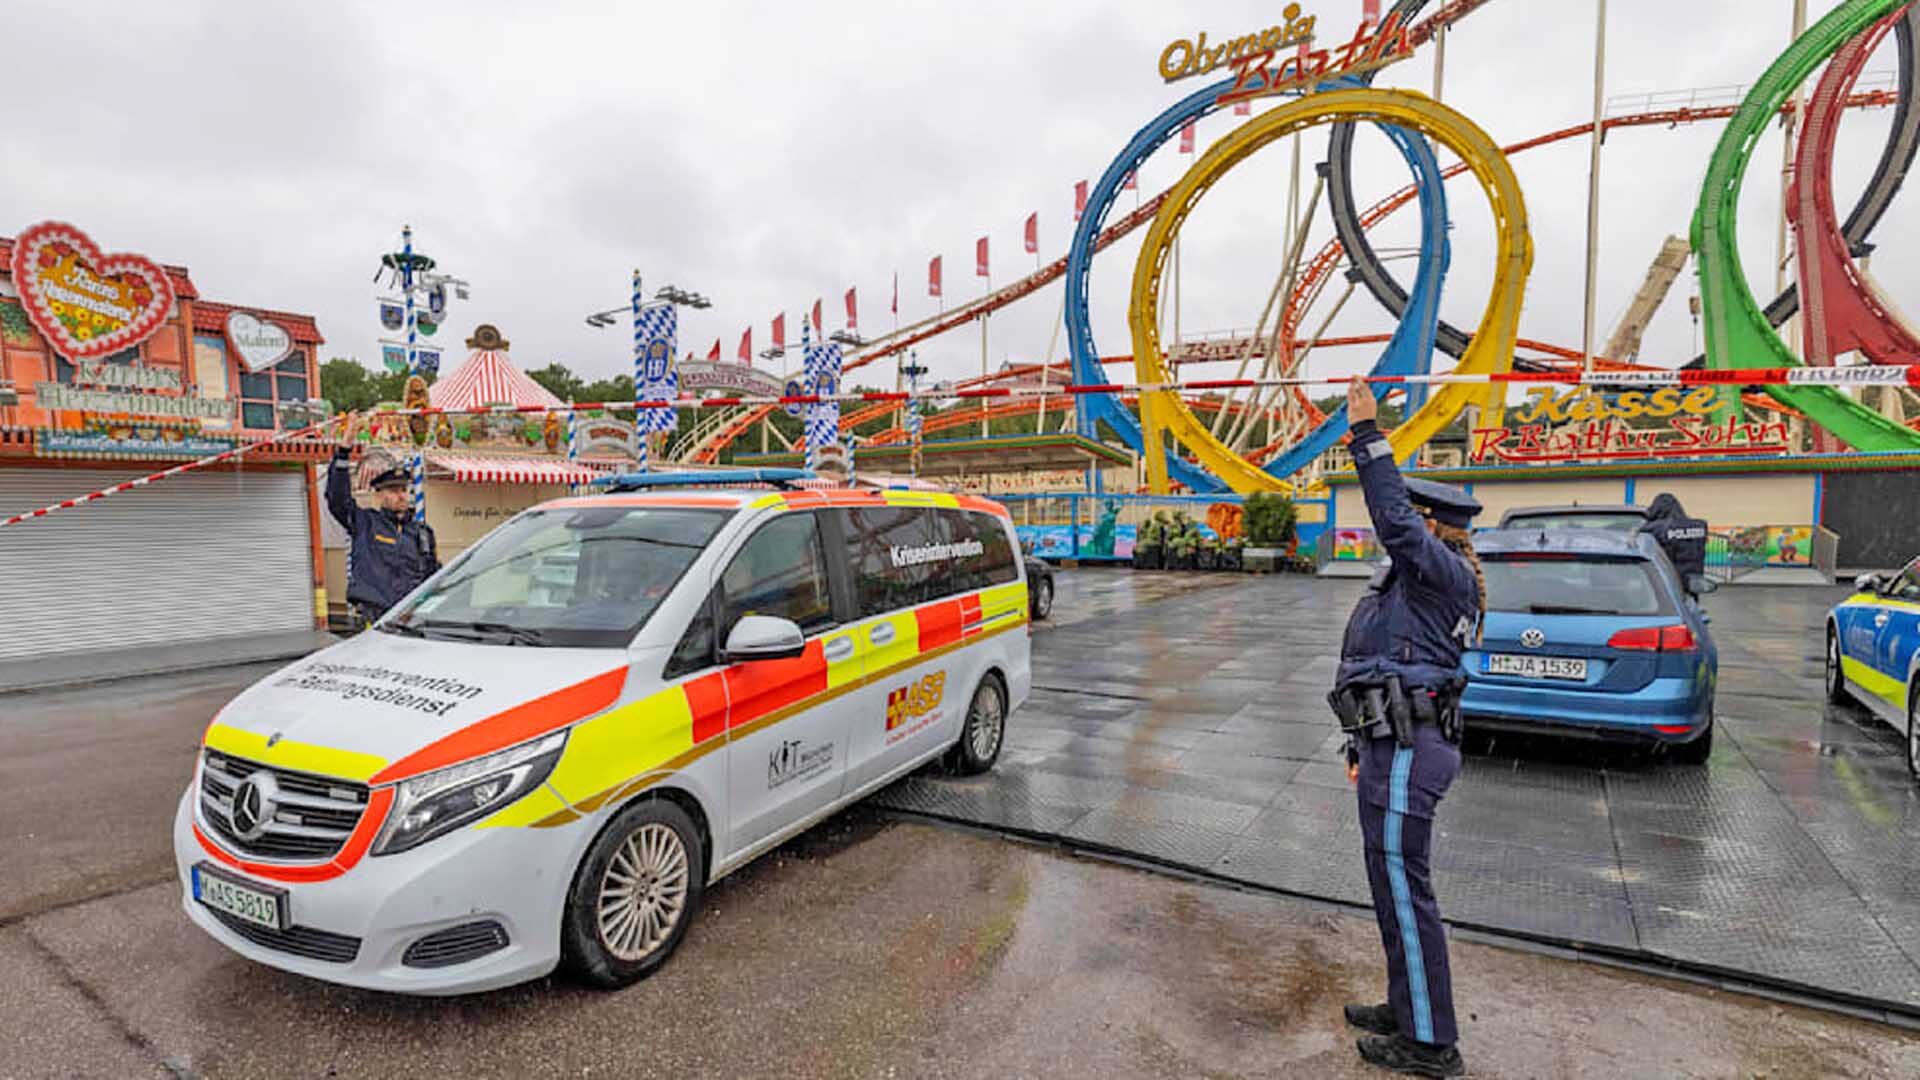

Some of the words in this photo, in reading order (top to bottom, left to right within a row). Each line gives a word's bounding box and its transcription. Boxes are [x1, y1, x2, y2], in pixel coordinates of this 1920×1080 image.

[1158, 2, 1317, 80] Olympia
[1215, 11, 1414, 105] Barth
[1516, 384, 1728, 423] Kasse
[1517, 420, 1629, 451] Barth
[1669, 415, 1790, 447] Sohn
[904, 670, 947, 726] ASB
